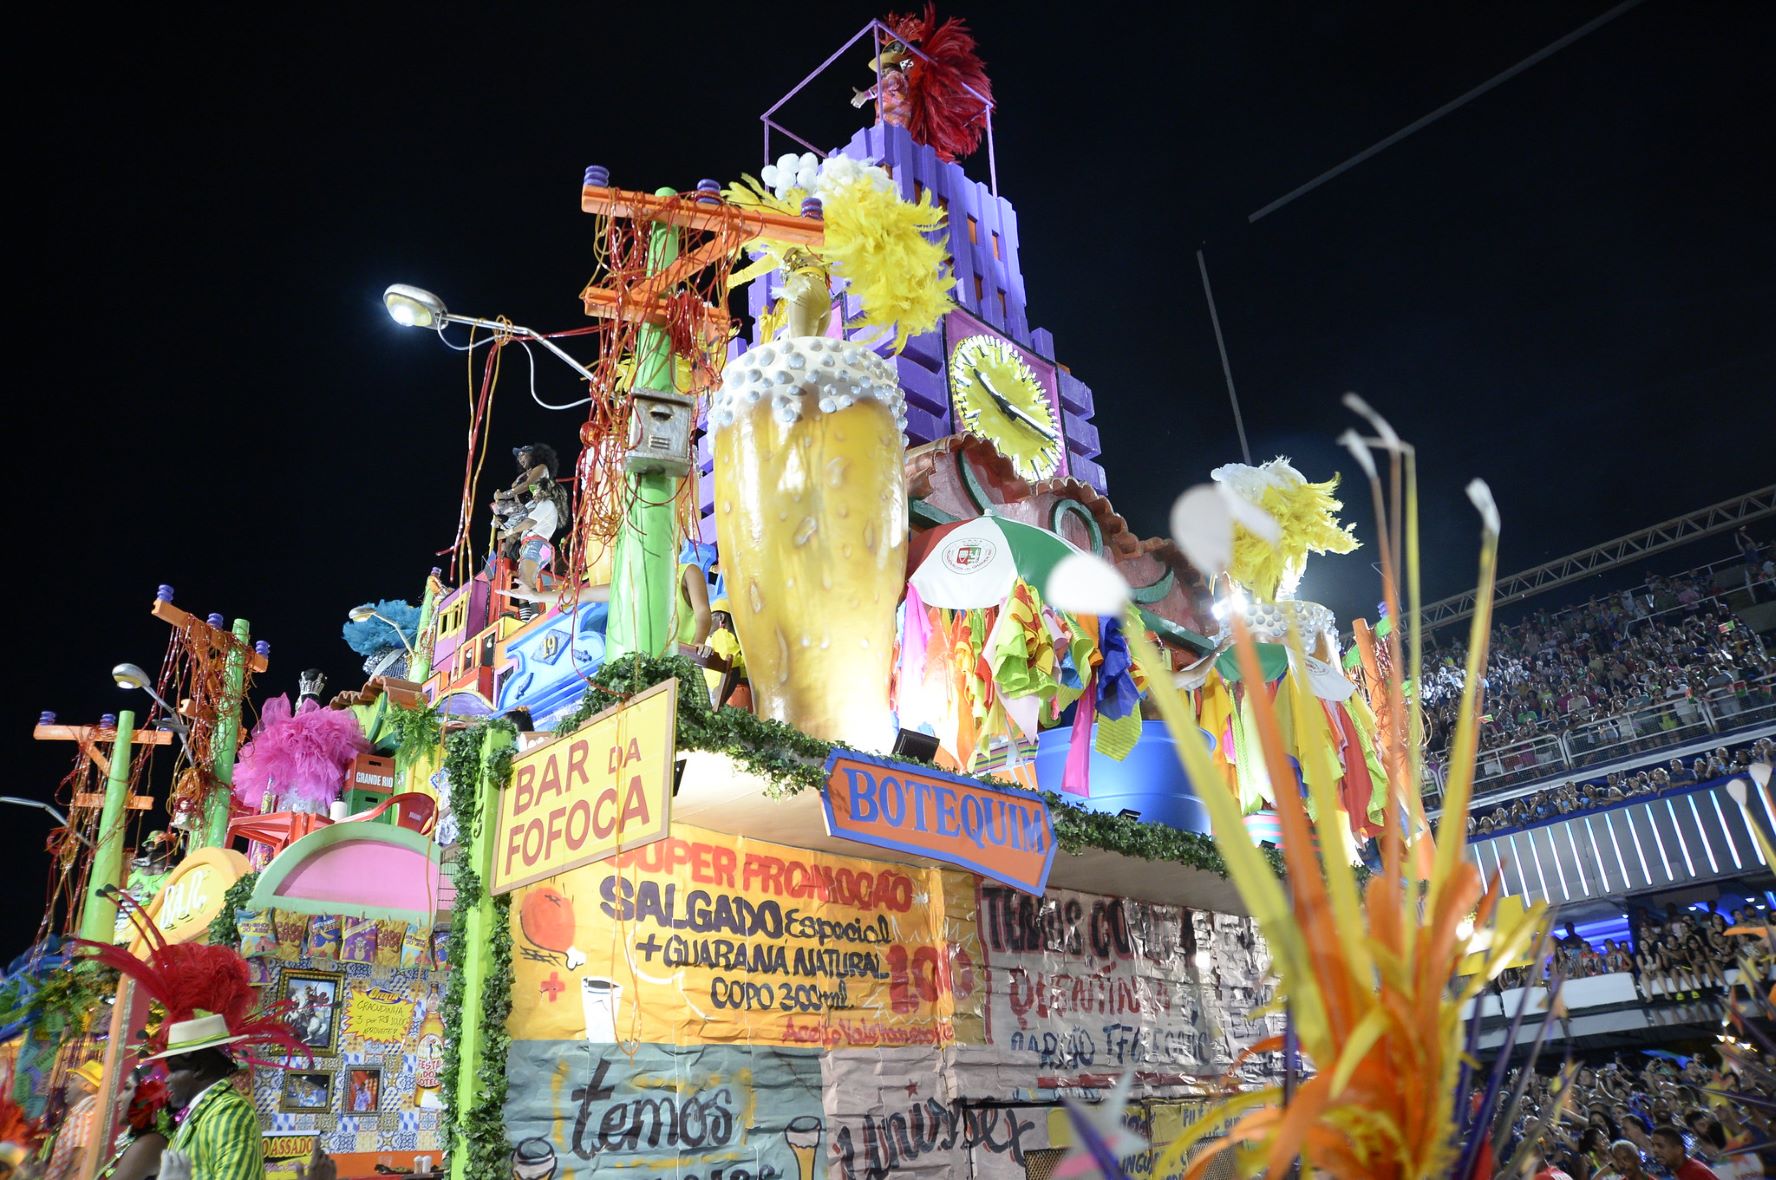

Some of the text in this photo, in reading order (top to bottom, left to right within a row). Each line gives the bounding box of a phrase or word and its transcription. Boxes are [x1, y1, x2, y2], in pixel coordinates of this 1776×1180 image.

[356, 771, 394, 788] GRANDE RIO
[513, 737, 642, 817] BAR DA
[504, 775, 650, 877] FOFOCA
[843, 767, 1045, 855] BOTEQUIM
[600, 875, 783, 939] SALGADO
[743, 853, 914, 913] PROMOÇÃO
[793, 943, 889, 980] NATURAL
[711, 977, 774, 1011] COPO
[571, 1057, 733, 1161] temos
[271, 1137, 313, 1156] ASSADO
